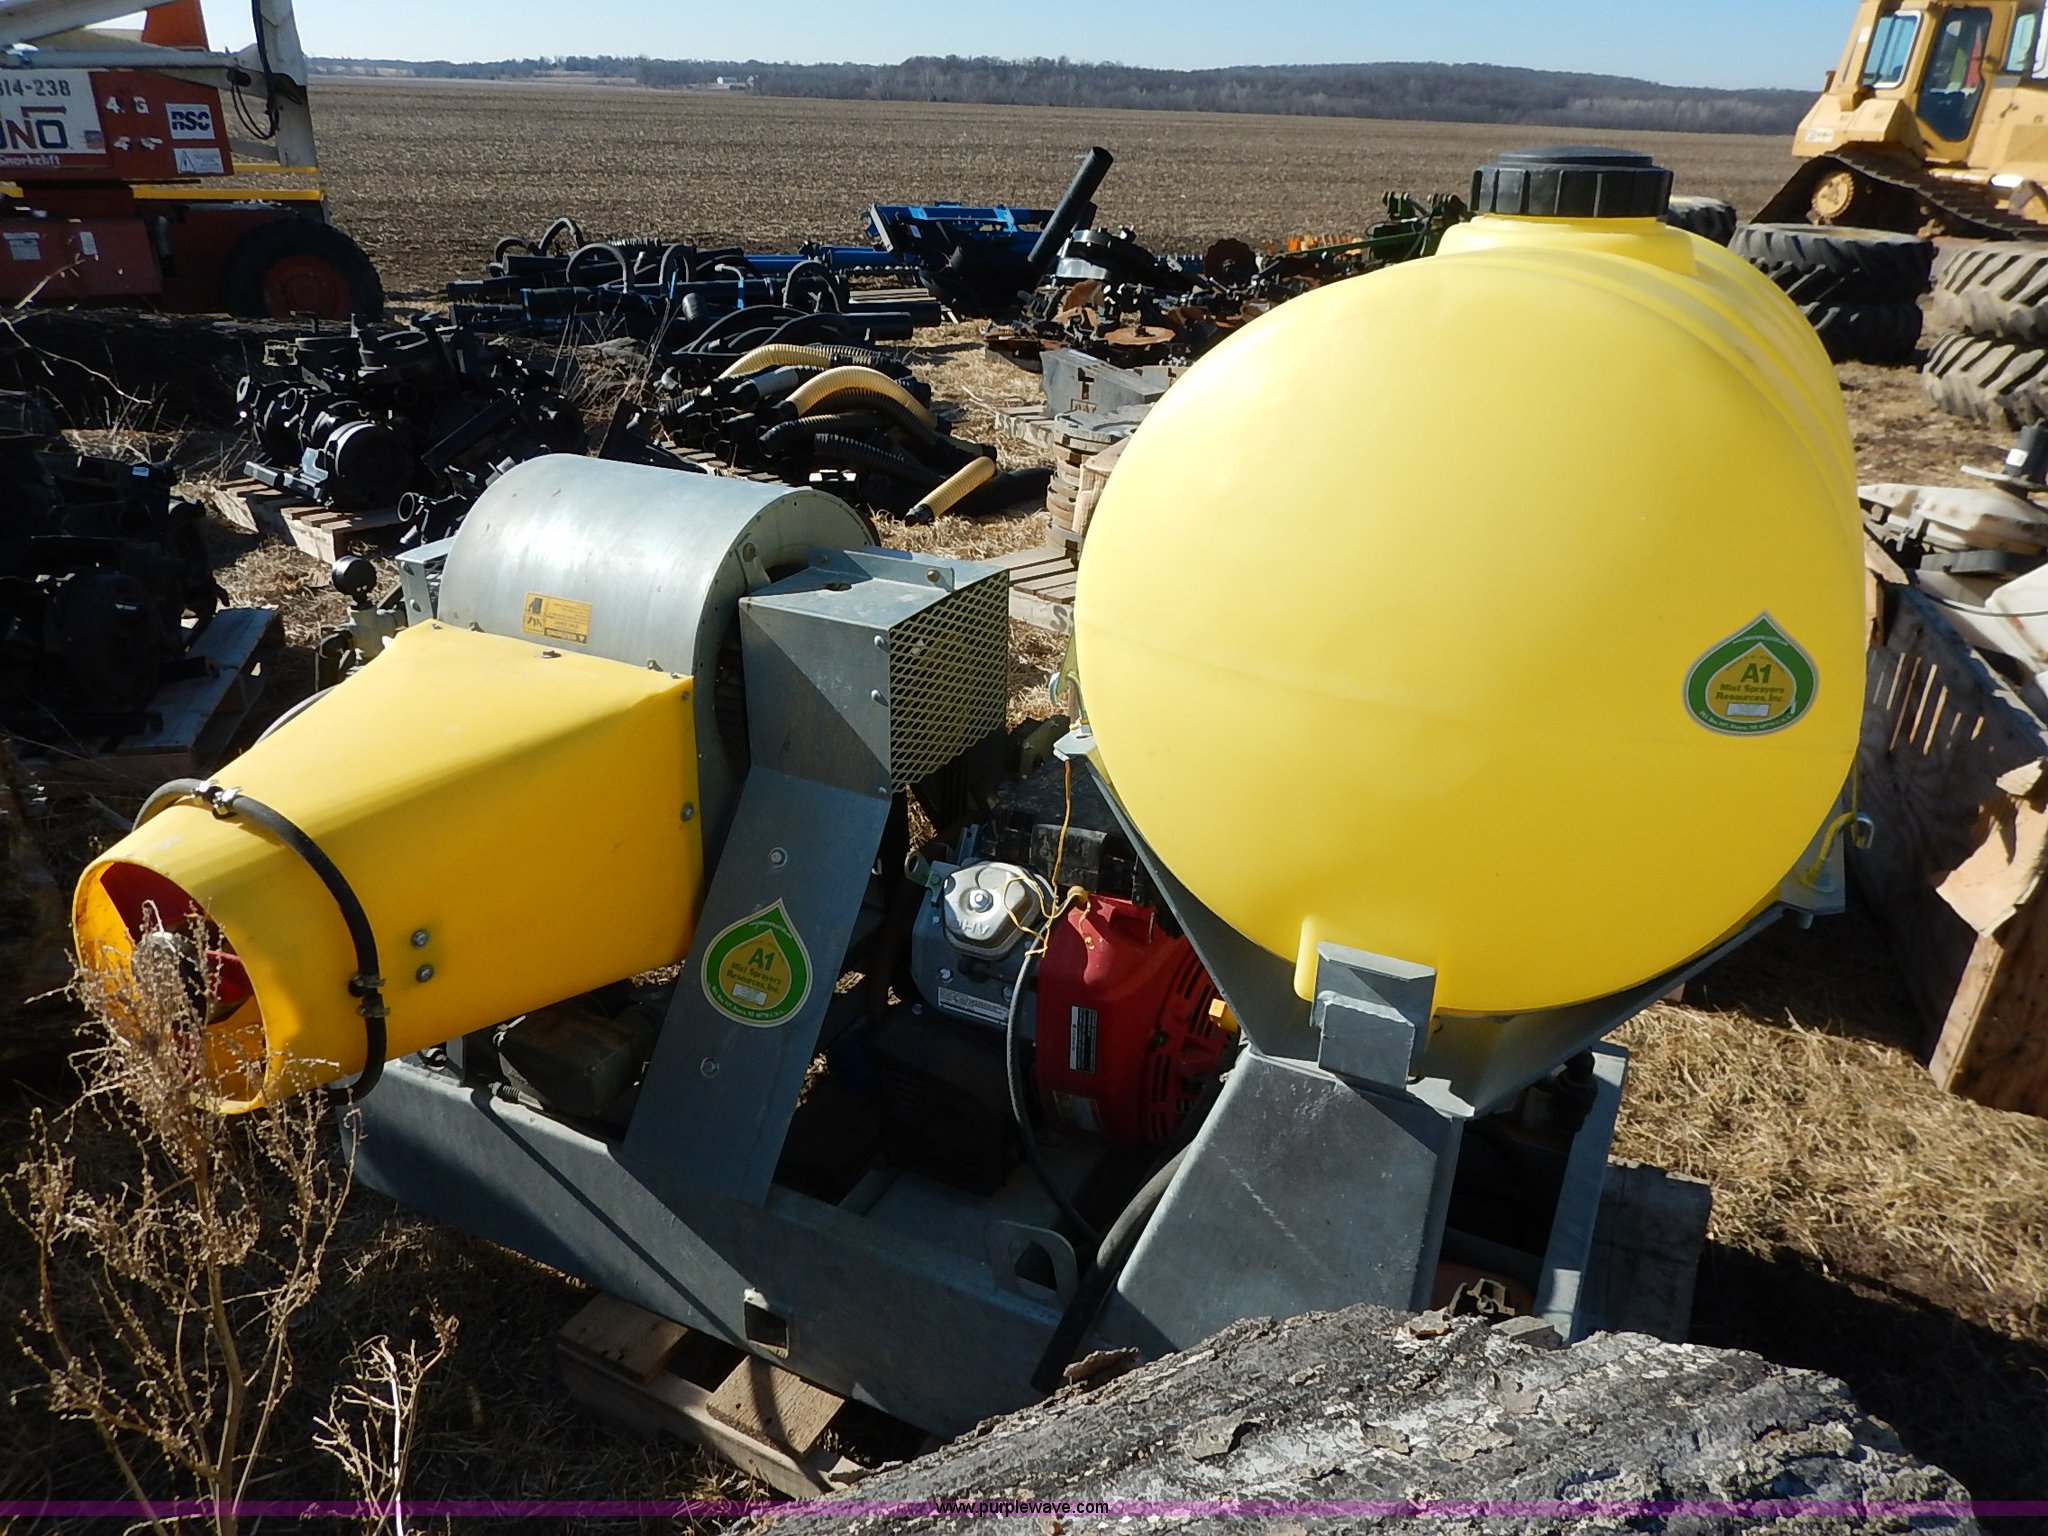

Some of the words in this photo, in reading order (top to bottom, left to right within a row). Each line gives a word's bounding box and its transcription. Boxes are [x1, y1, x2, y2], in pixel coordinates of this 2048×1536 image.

[0, 110, 69, 149] NO
[171, 111, 210, 131] RSC
[1740, 663, 1772, 684] A1
[1719, 683, 1741, 692] Mist
[1744, 684, 1785, 694] Sprayers
[748, 948, 775, 971] A1
